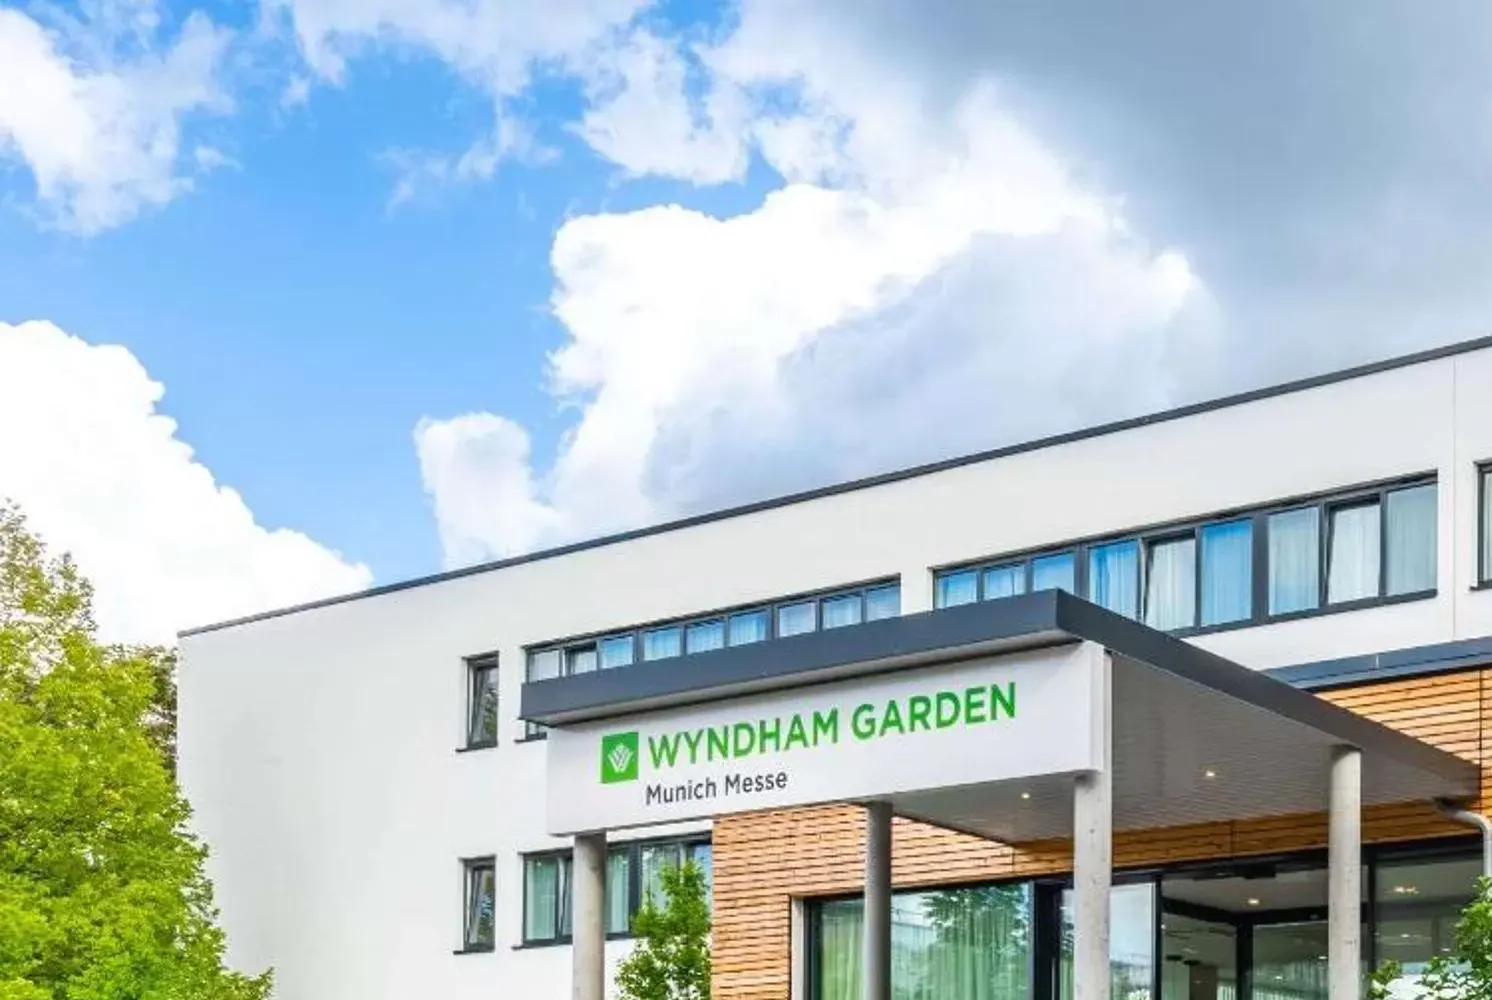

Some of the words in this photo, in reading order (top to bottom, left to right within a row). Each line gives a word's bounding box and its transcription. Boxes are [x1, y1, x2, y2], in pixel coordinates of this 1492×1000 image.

[647, 707, 839, 770] WYNDHAM
[851, 681, 1017, 740] GARDEN
[645, 776, 718, 806] Munich
[724, 771, 789, 796] Messe
